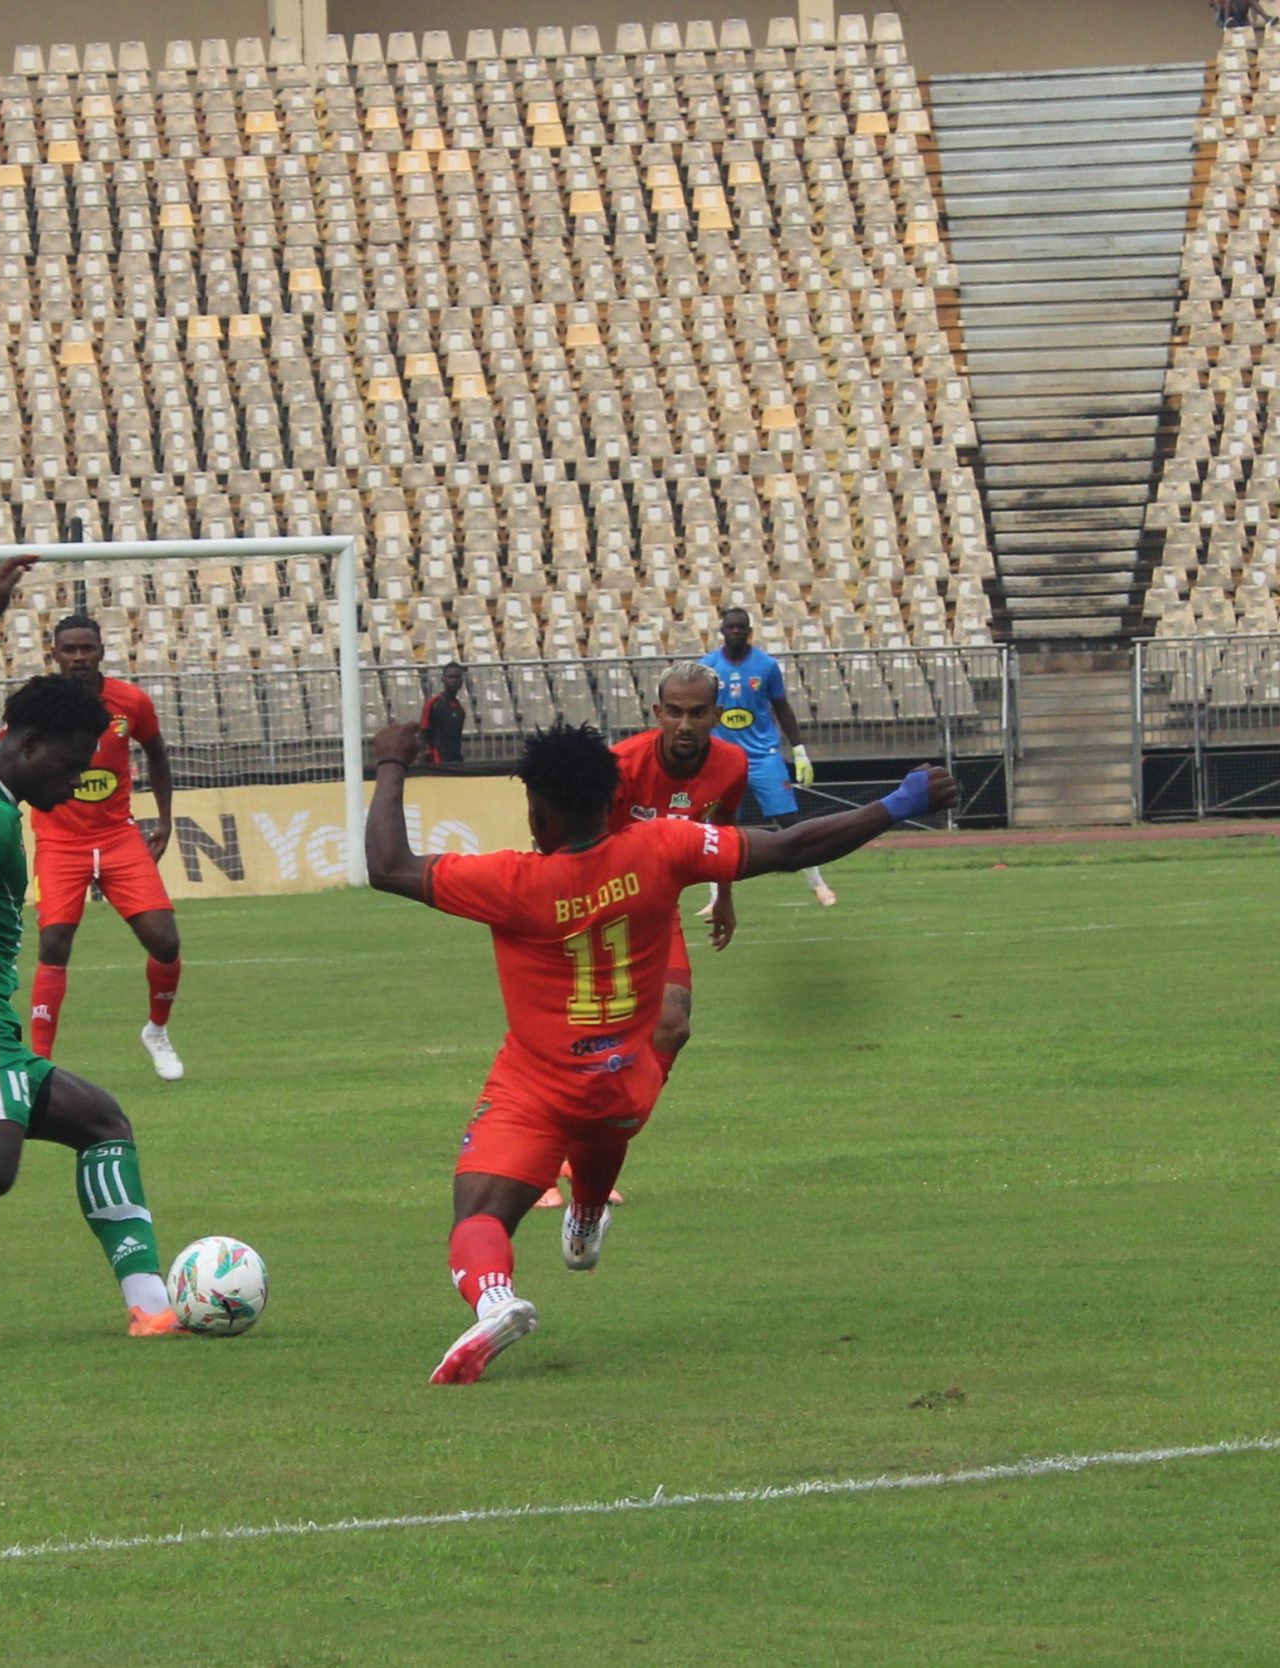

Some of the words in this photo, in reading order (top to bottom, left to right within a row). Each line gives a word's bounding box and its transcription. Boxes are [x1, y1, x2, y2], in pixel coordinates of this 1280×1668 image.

[252, 804, 480, 881] Yao
[555, 871, 641, 924] BELOBO
[563, 914, 638, 1025] 11
